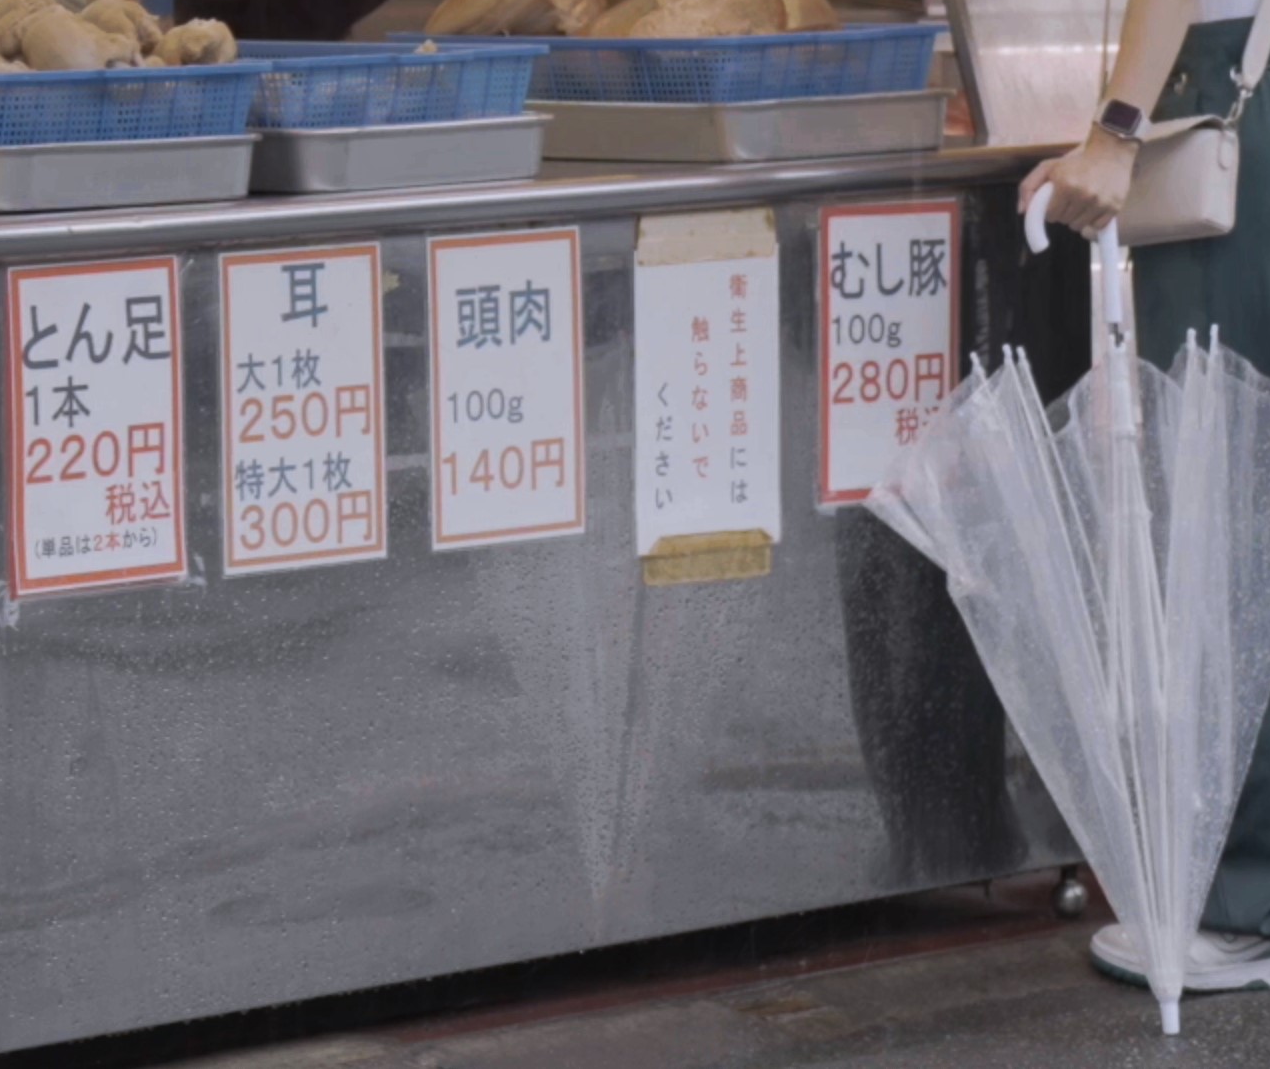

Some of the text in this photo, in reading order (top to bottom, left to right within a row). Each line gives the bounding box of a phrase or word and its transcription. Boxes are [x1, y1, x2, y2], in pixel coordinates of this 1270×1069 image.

[282, 262, 328, 327] 耳
[830, 238, 947, 299] むし豚
[22, 295, 171, 370] とん足
[455, 280, 551, 349] 頭肉
[831, 314, 902, 346] 100g
[237, 349, 321, 393] 大1枚
[691, 316, 709, 478] 触らないで
[729, 273, 748, 504] 衛生上商品には
[832, 353, 946, 405] 280円
[26, 375, 91, 428] 1本
[238, 384, 372, 443] 250円
[447, 388, 524, 425] 100g
[26, 422, 165, 485] 220円
[442, 437, 565, 496] 140円
[655, 382, 673, 510] ください
[105, 481, 171, 525] 税込
[235, 453, 353, 501] 特大1枚
[239, 490, 374, 551] 300円
